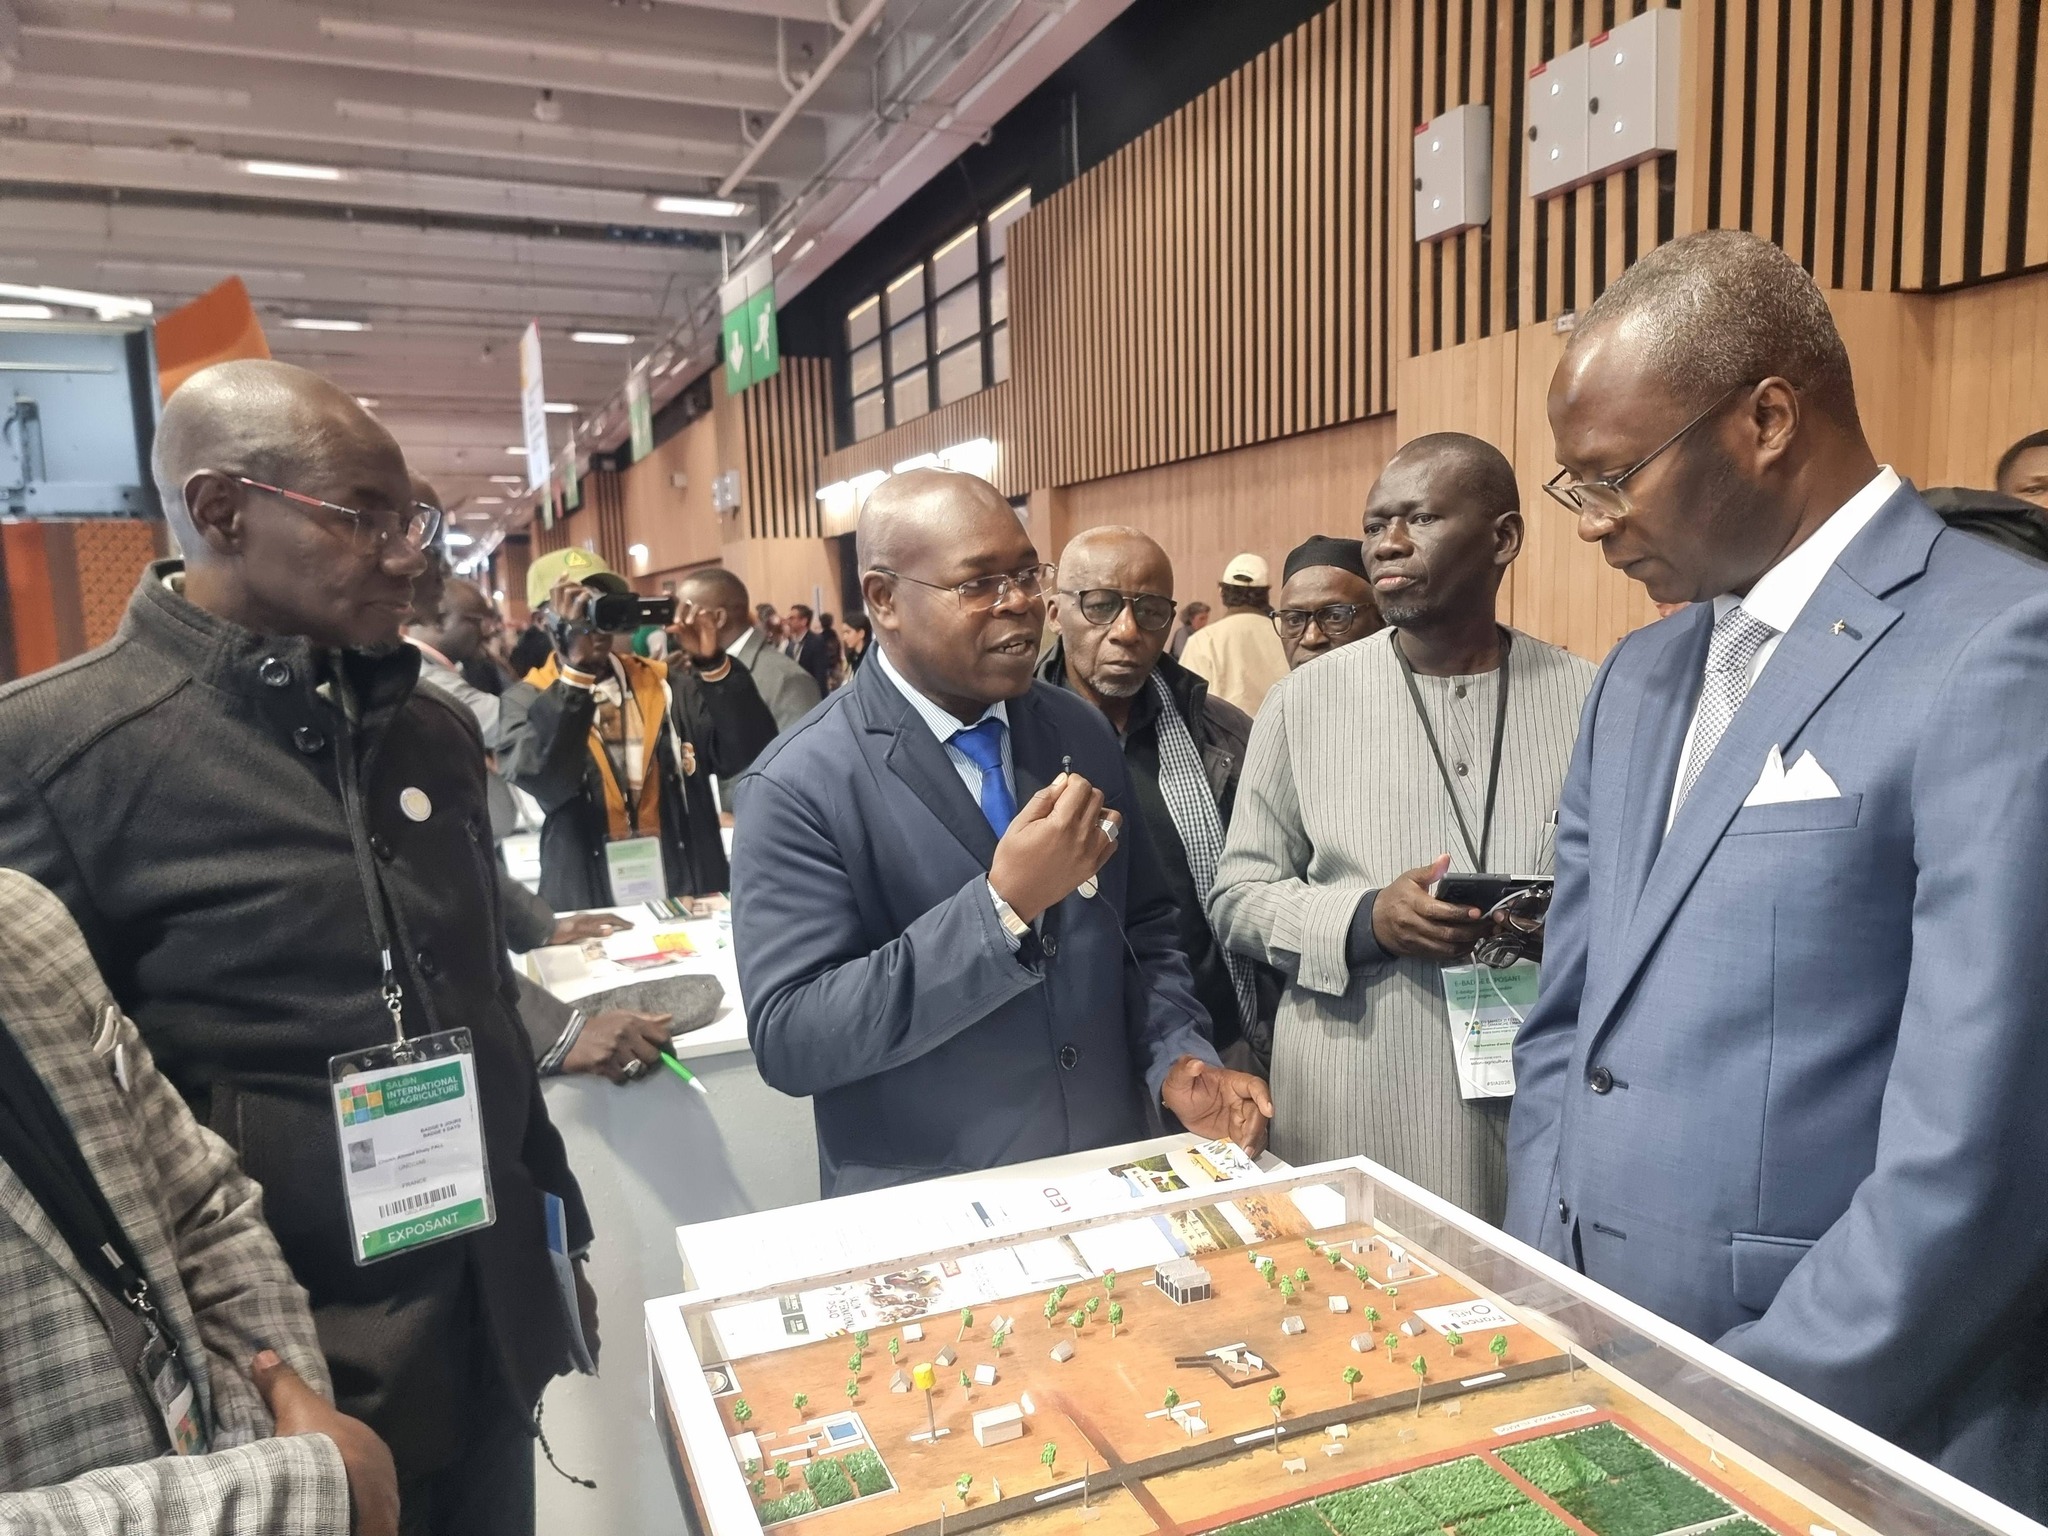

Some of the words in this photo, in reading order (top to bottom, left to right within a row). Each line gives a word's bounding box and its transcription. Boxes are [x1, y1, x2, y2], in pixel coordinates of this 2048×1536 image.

[1454, 978, 1485, 987] E-BADE
[1486, 975, 1521, 984] EPOSANT
[386, 1076, 417, 1090] SALON
[387, 1075, 458, 1100] INTERNATIONAL
[402, 1177, 427, 1188] FRANCE
[388, 1212, 459, 1244] EXPOSANT
[1461, 1314, 1507, 1326] France
